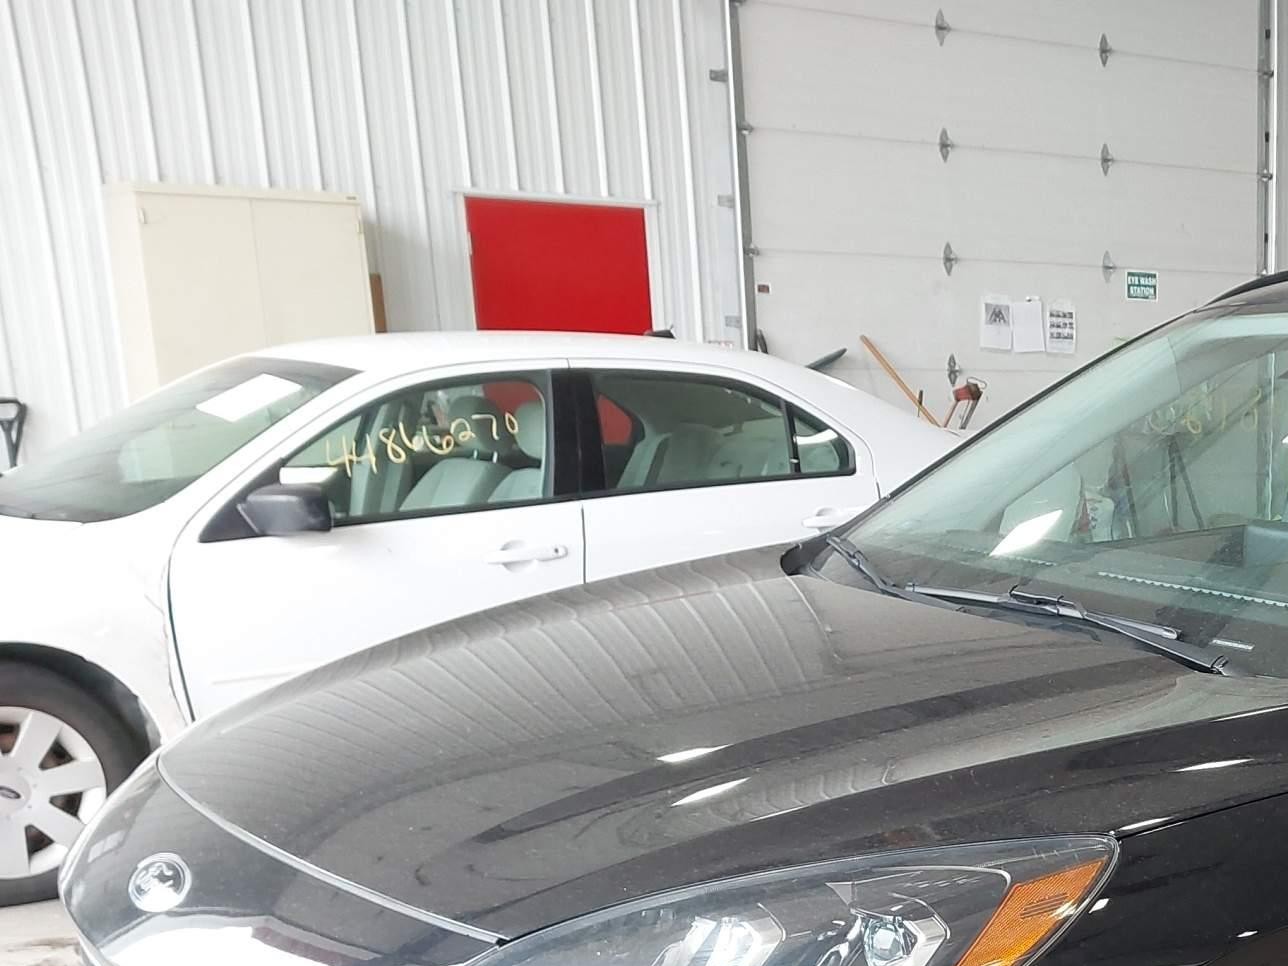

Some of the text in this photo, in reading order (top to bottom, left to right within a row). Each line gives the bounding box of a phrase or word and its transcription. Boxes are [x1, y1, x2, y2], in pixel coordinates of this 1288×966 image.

[1127, 276, 1139, 285] EYE
[1130, 286, 1155, 297] STATION
[326, 411, 519, 478] 44866270
